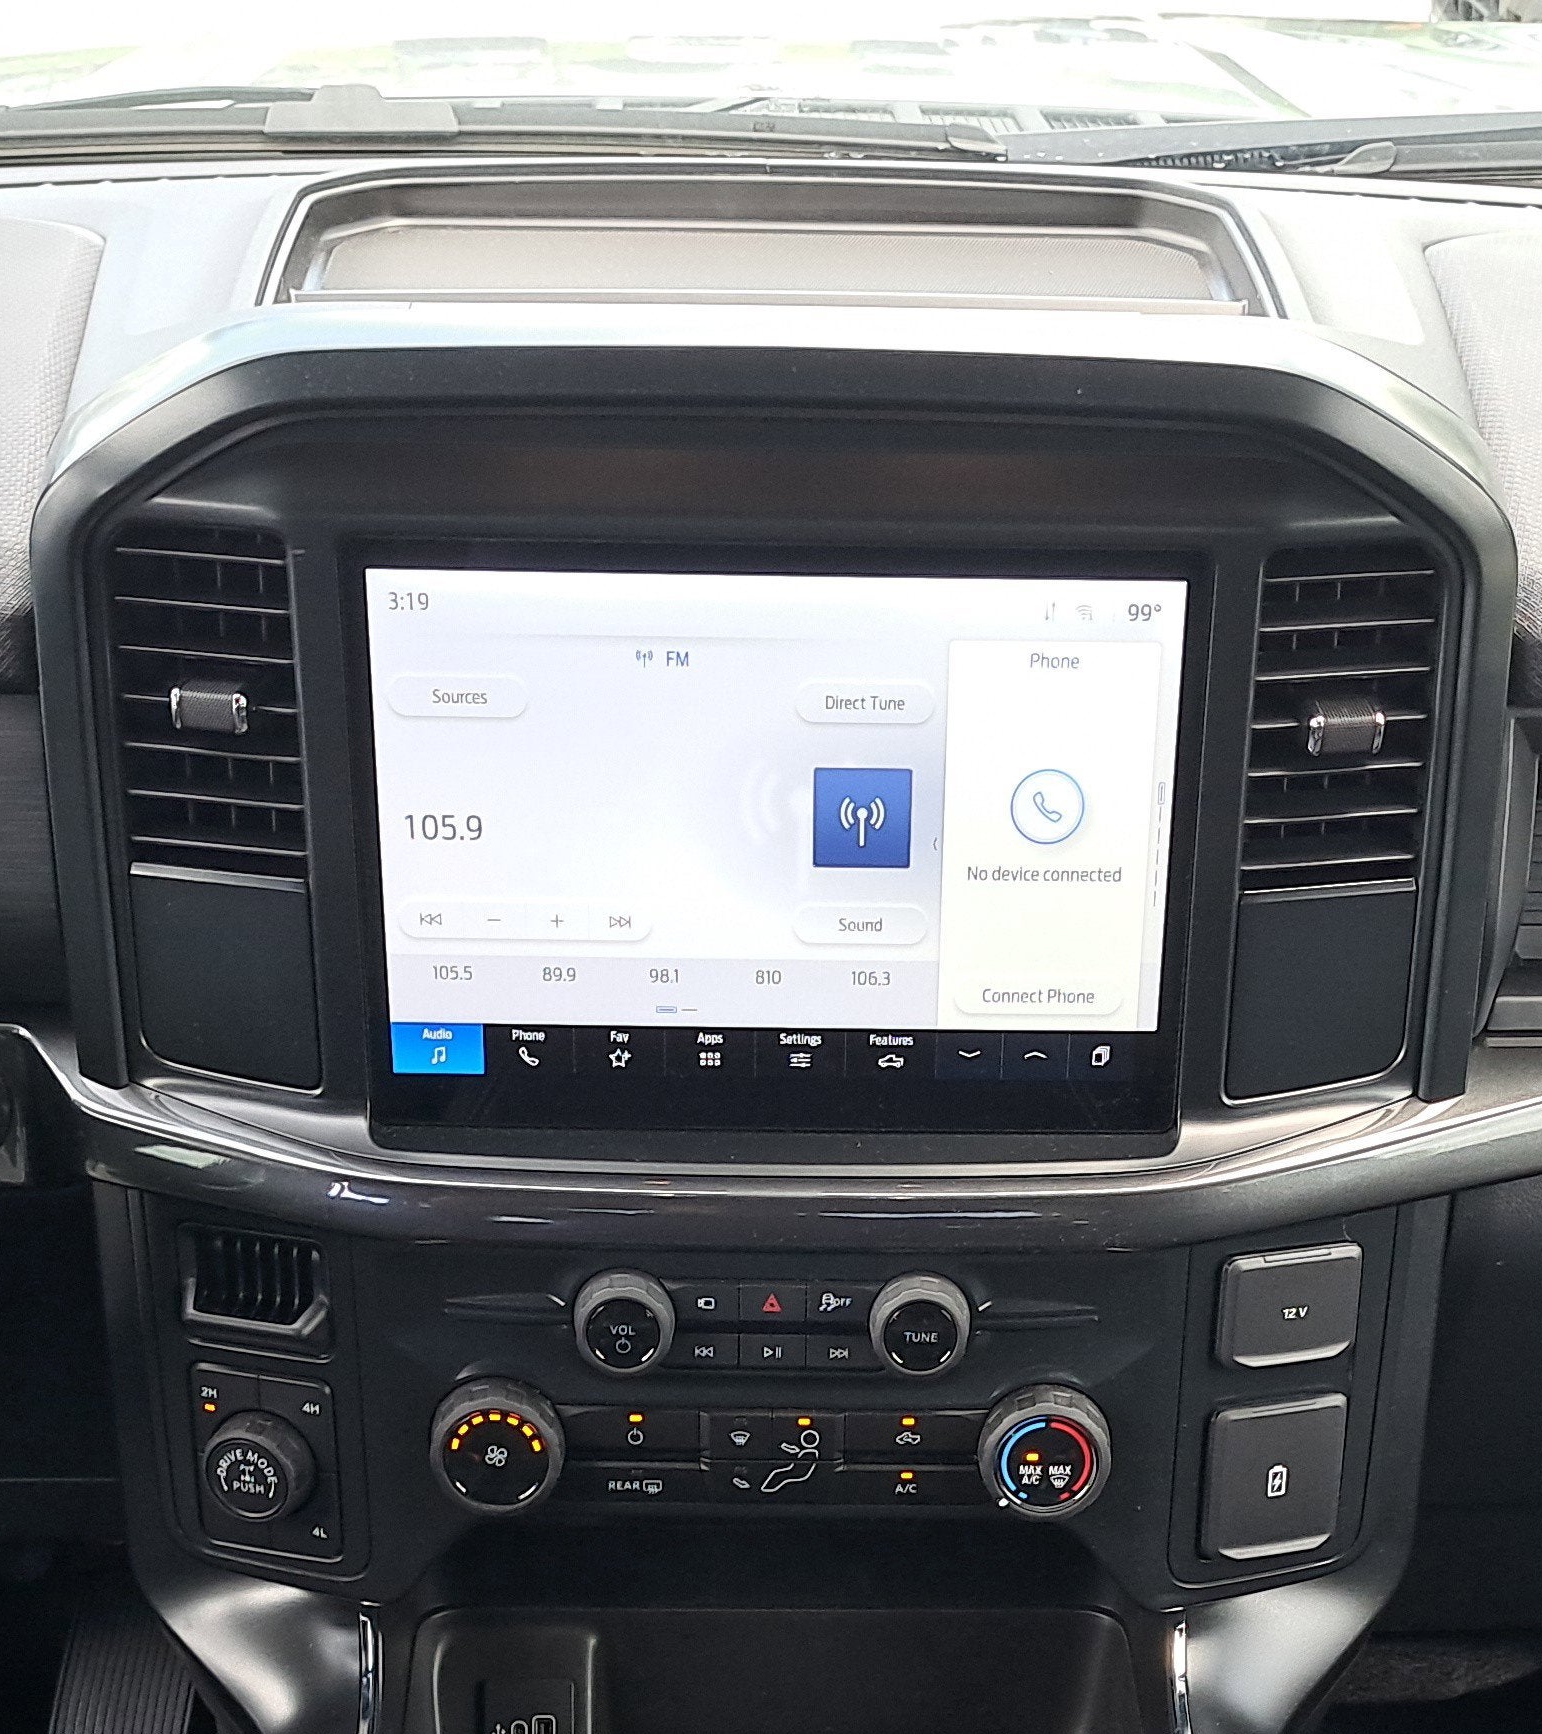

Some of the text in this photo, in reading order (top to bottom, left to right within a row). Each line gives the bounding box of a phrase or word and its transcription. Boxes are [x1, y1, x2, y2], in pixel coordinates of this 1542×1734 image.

[388, 591, 429, 611] 3:19
[666, 651, 690, 668] FM
[1030, 653, 1080, 670] Phone
[432, 688, 488, 705] Sources
[825, 695, 906, 712] Direct Tune
[404, 814, 483, 841] 105.9
[967, 866, 1122, 883] No device connected
[838, 917, 883, 933] Sound
[432, 965, 473, 981] 105.5
[542, 967, 577, 982] 89.9
[649, 968, 679, 984] 98.1
[755, 970, 781, 985] 810
[851, 971, 891, 987] 106.3
[981, 988, 1096, 1005] Connect Phone
[422, 1028, 453, 1040] Audio
[511, 1029, 546, 1041] Phone
[610, 1030, 630, 1044] Fav
[696, 1032, 723, 1046] Apps
[779, 1032, 822, 1047] Settings
[869, 1034, 914, 1046] Features
[832, 1296, 853, 1308] OFF
[609, 1324, 637, 1337] VOL
[903, 1331, 939, 1344] TUNE
[200, 1386, 218, 1399] 2H
[301, 1402, 320, 1416] 4H
[216, 1449, 279, 1485] DRIVE MODE
[1019, 1465, 1043, 1476] MAX
[1048, 1465, 1073, 1477] MAX
[232, 1480, 265, 1495] PUSH
[608, 1480, 640, 1491] REAR
[1021, 1476, 1041, 1486] A/C
[895, 1483, 918, 1495] A/C
[312, 1526, 328, 1539] 4L
